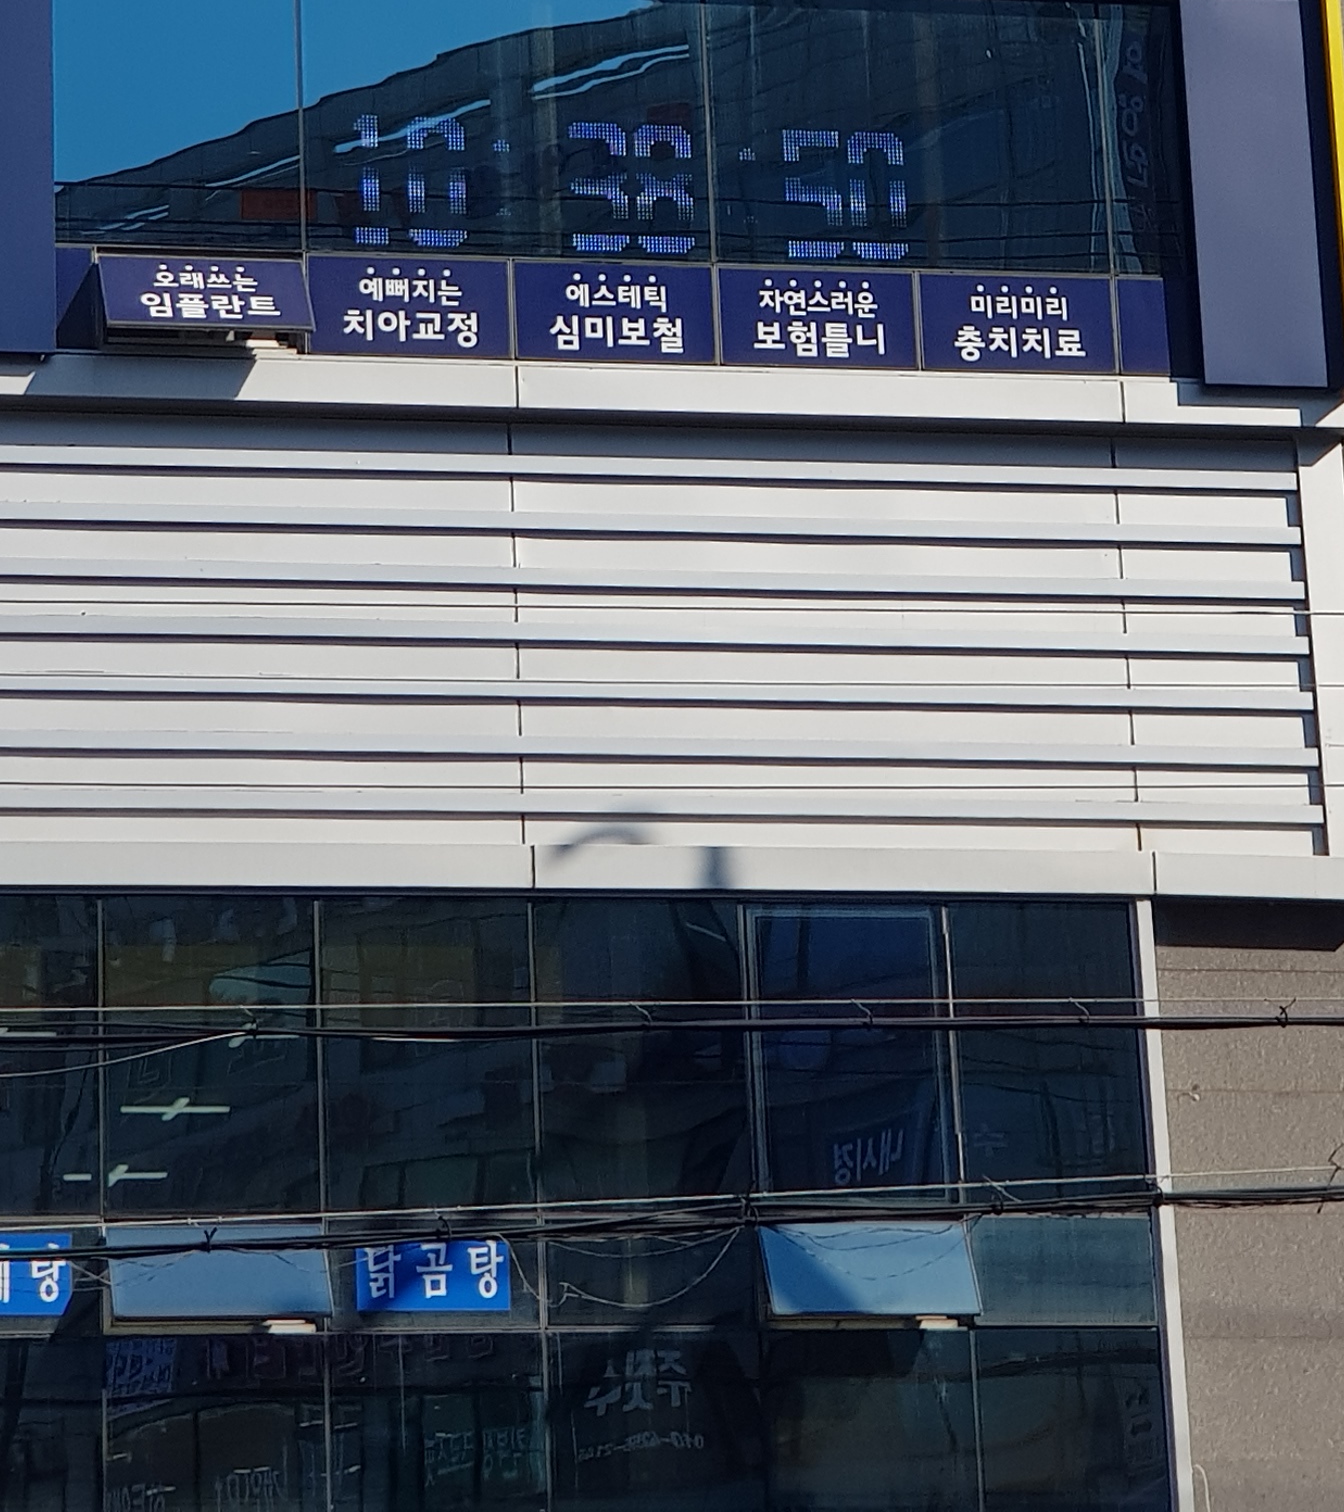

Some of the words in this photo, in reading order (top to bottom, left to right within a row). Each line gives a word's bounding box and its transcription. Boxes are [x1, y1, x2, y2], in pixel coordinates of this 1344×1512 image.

[153, 267, 259, 293] 오래쓰는
[358, 276, 463, 304] 예뻐지는
[140, 292, 282, 319] 임플란트
[566, 283, 667, 313] 에스테틱
[758, 288, 878, 318] 자연스러운
[970, 293, 1069, 321] 미리미리
[343, 308, 480, 349] 치아교정
[550, 314, 685, 355] 심미보철
[754, 321, 887, 358] 보험틀니
[954, 325, 1087, 362] 충치치료
[364, 1239, 505, 1299] 닭곰탕
